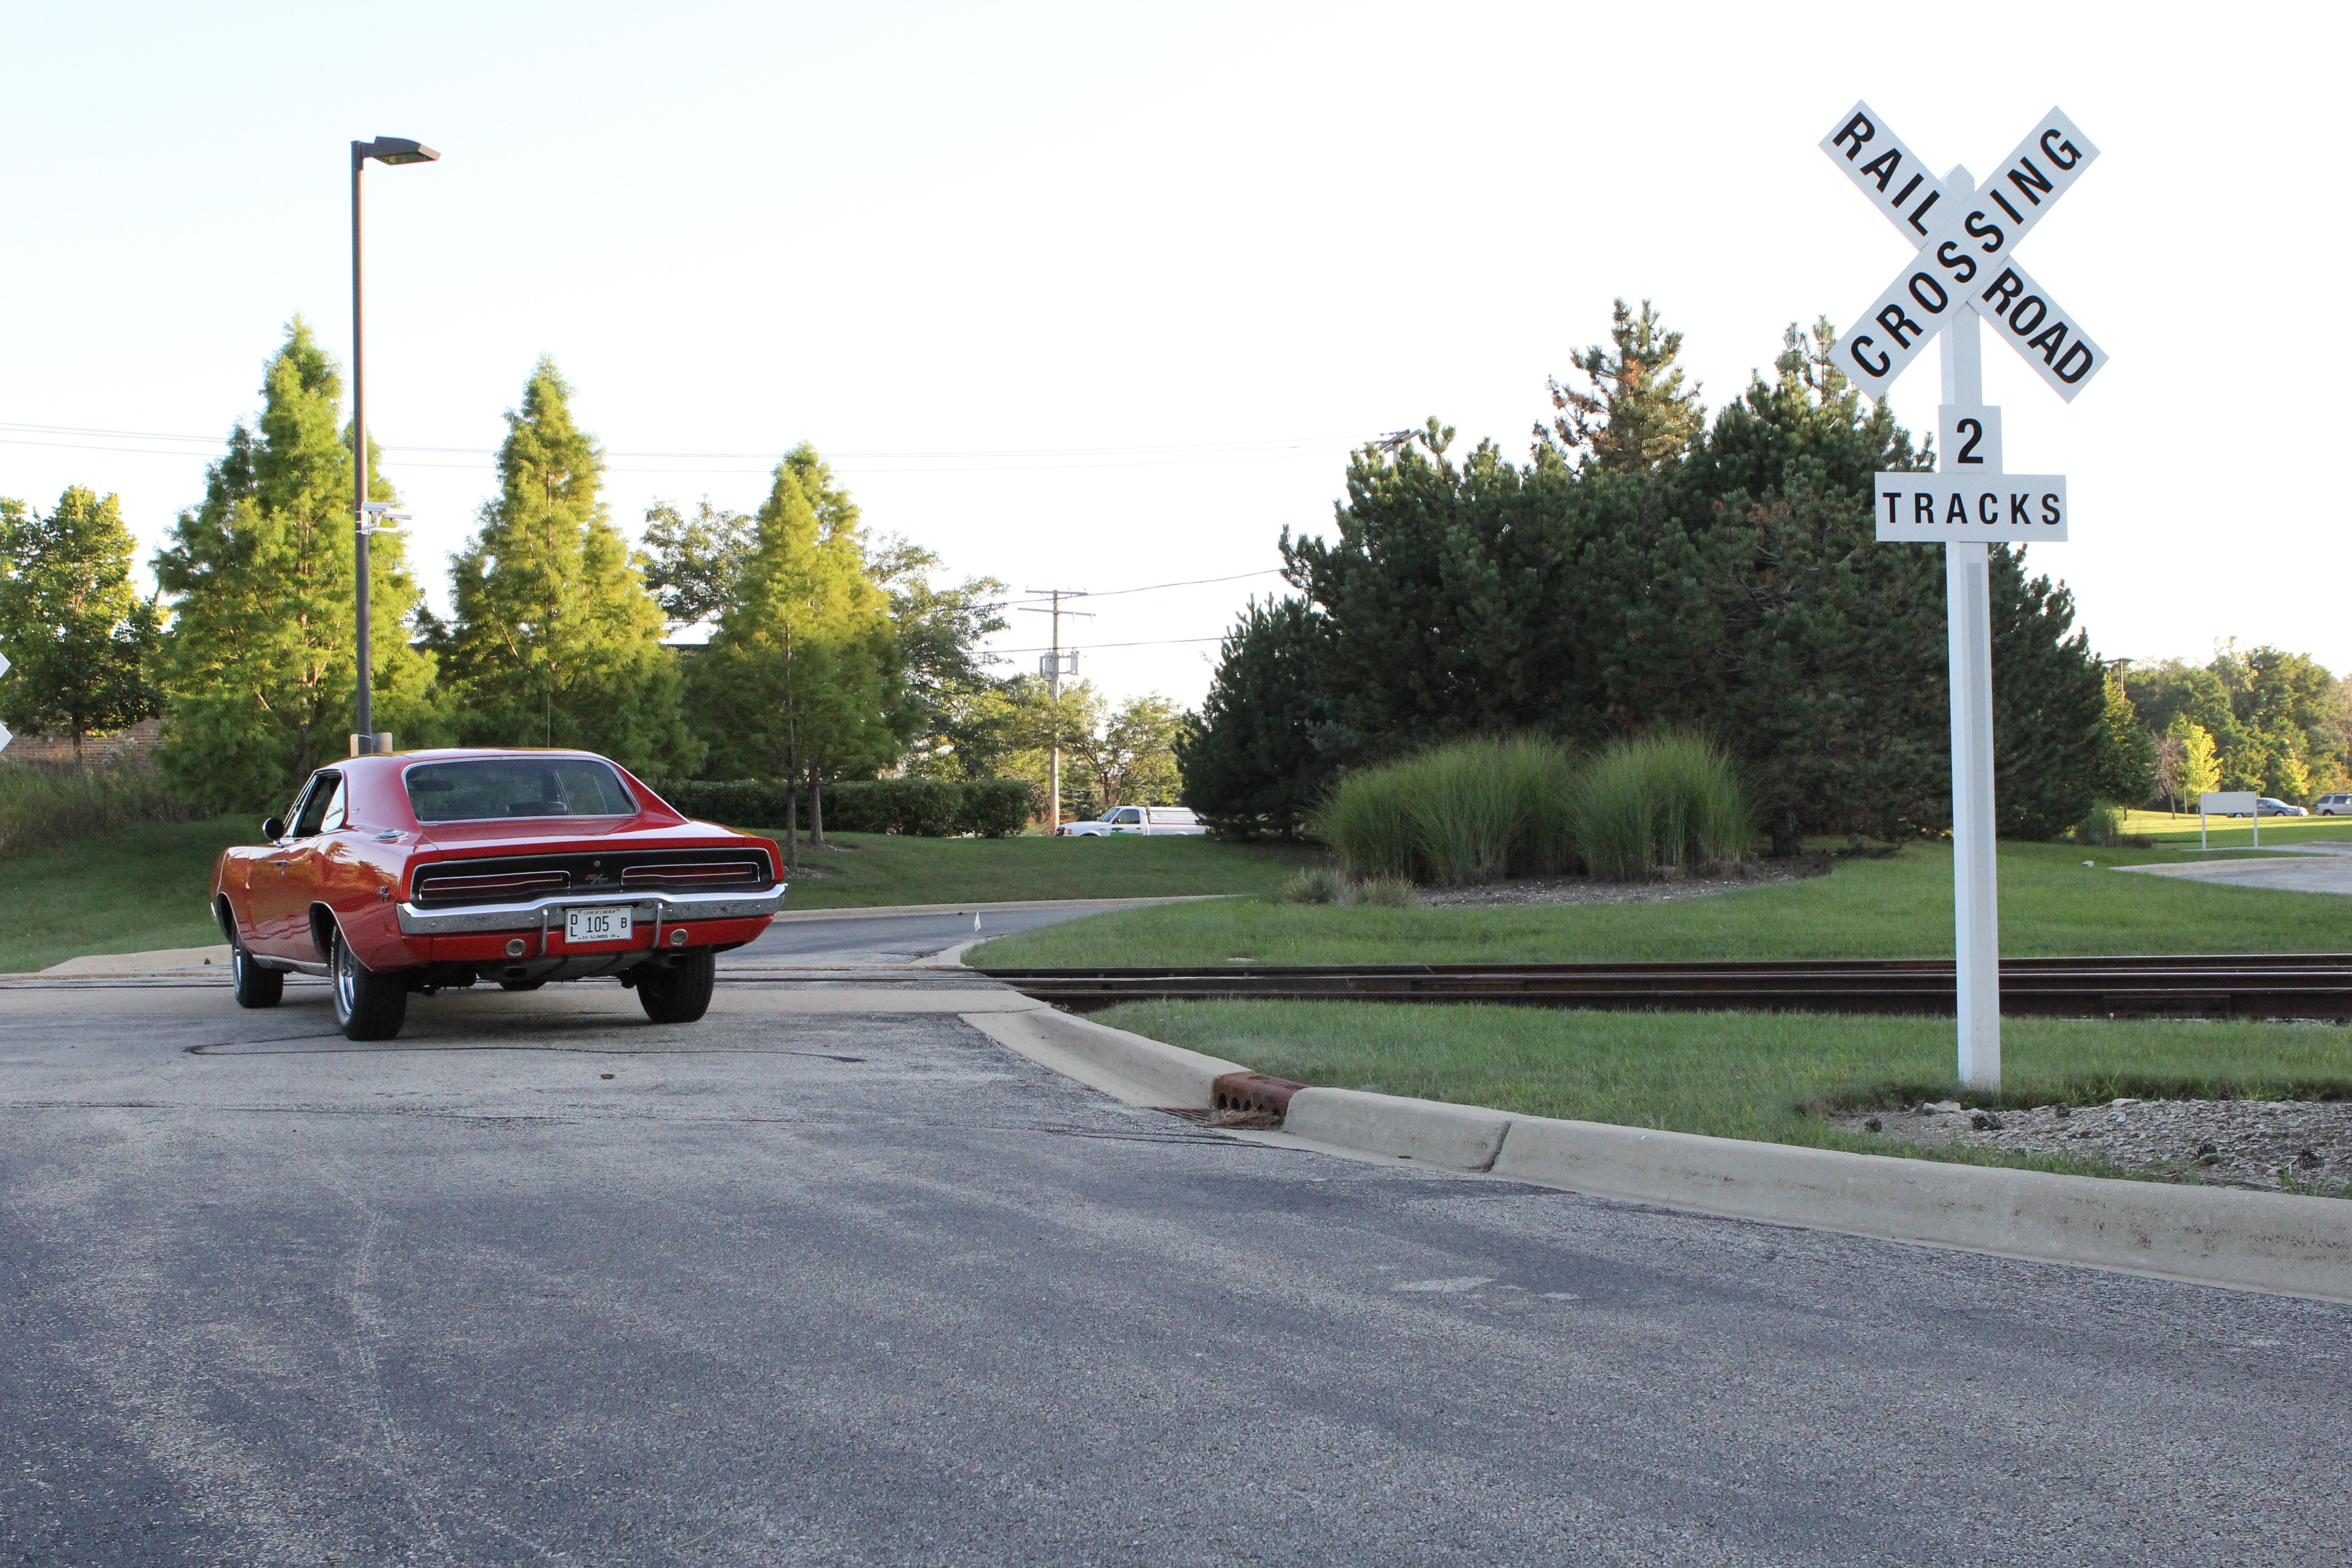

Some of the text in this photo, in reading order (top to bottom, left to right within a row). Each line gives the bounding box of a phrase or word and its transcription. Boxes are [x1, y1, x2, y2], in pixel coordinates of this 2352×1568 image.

[1832, 111, 2093, 384] RAIL ROAD
[1851, 129, 2082, 377] CROSSING
[1956, 418, 1984, 464] 2
[1882, 492, 2060, 525] TRACKS
[587, 916, 627, 933] 105 B
